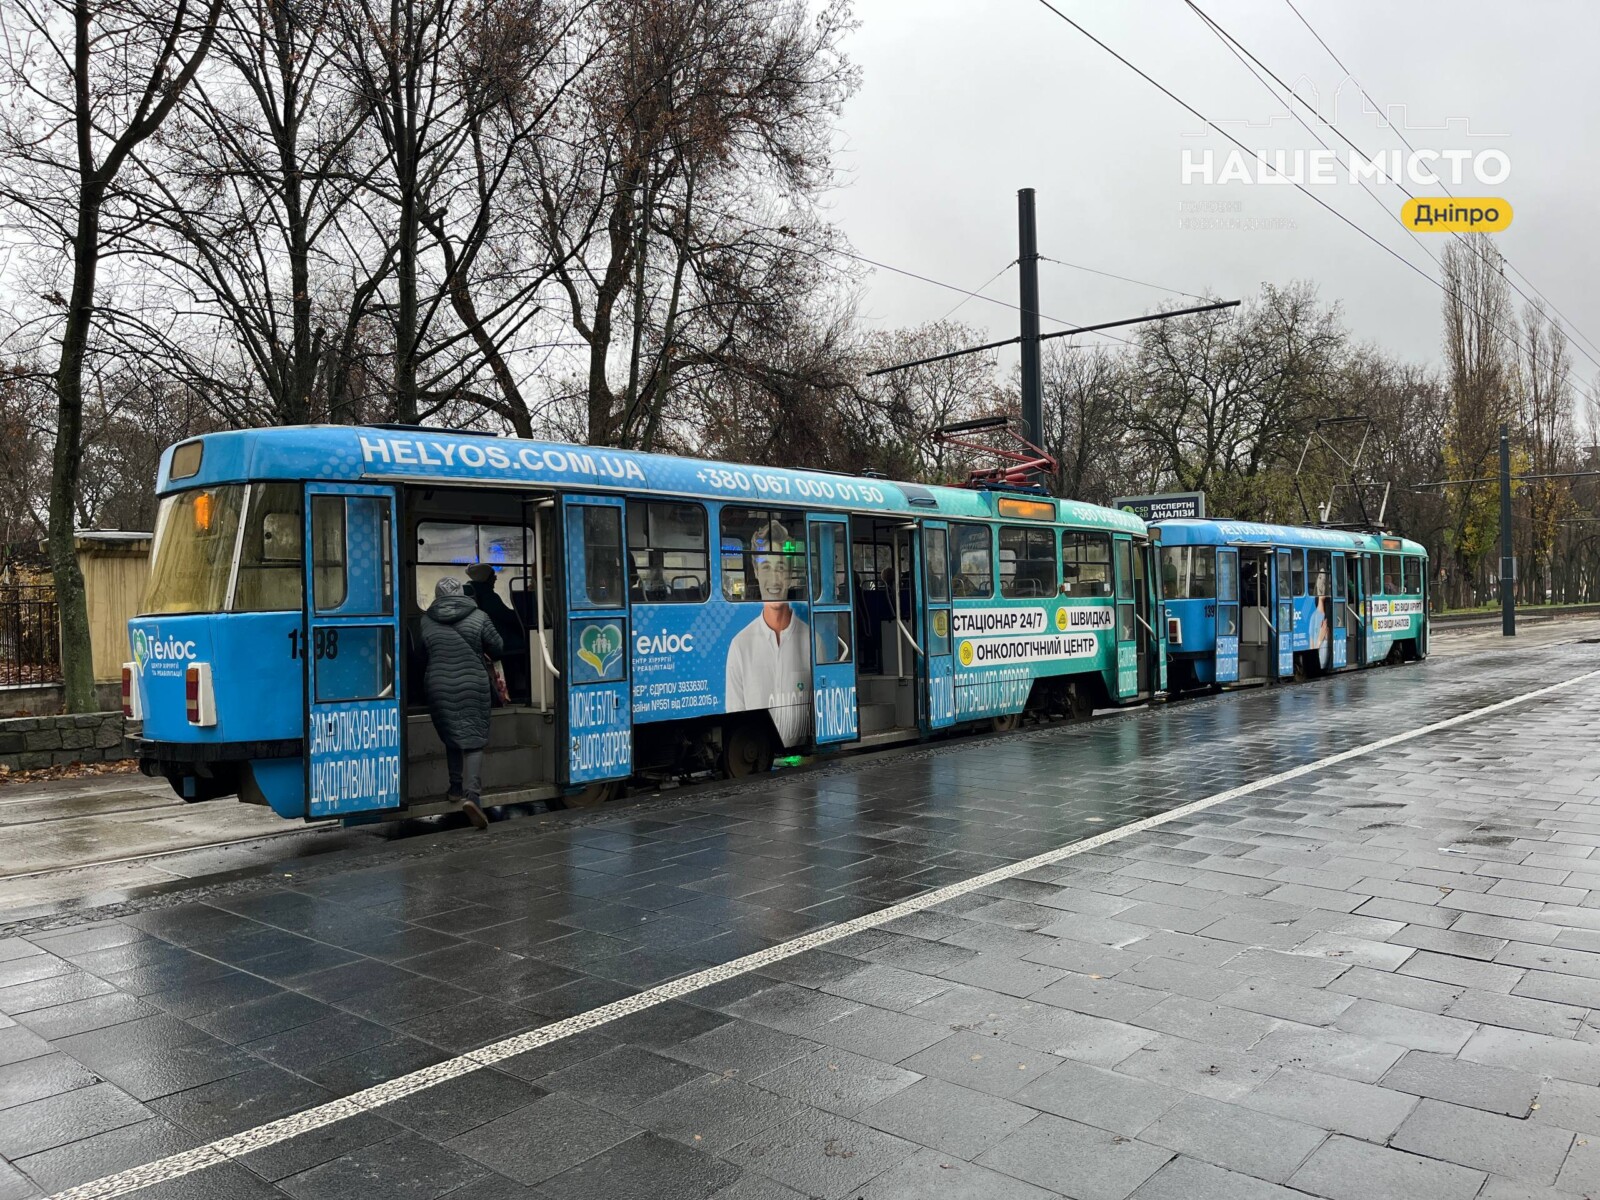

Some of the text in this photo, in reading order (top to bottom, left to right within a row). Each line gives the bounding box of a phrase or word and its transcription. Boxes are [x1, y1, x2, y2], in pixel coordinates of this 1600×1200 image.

[360, 437, 646, 481] HELYOS.COM.UA
[696, 468, 751, 491] +380
[751, 473, 790, 495] 067
[794, 478, 834, 499] 000
[1151, 502, 1195, 511] ЕКСПЕРТНІ
[1152, 509, 1195, 519] АНАЛІЗИ
[953, 612, 1043, 633] СТАЦІОНАР 24/7
[1070, 611, 1111, 627] ШВИДКА
[976, 636, 1095, 661] ОНКОЛОГІЧНИЙ ЦЕНТР
[571, 692, 595, 728] МОЖЕ
[826, 687, 858, 736] МОЖЕ
[378, 755, 399, 804] ДЛЯ
